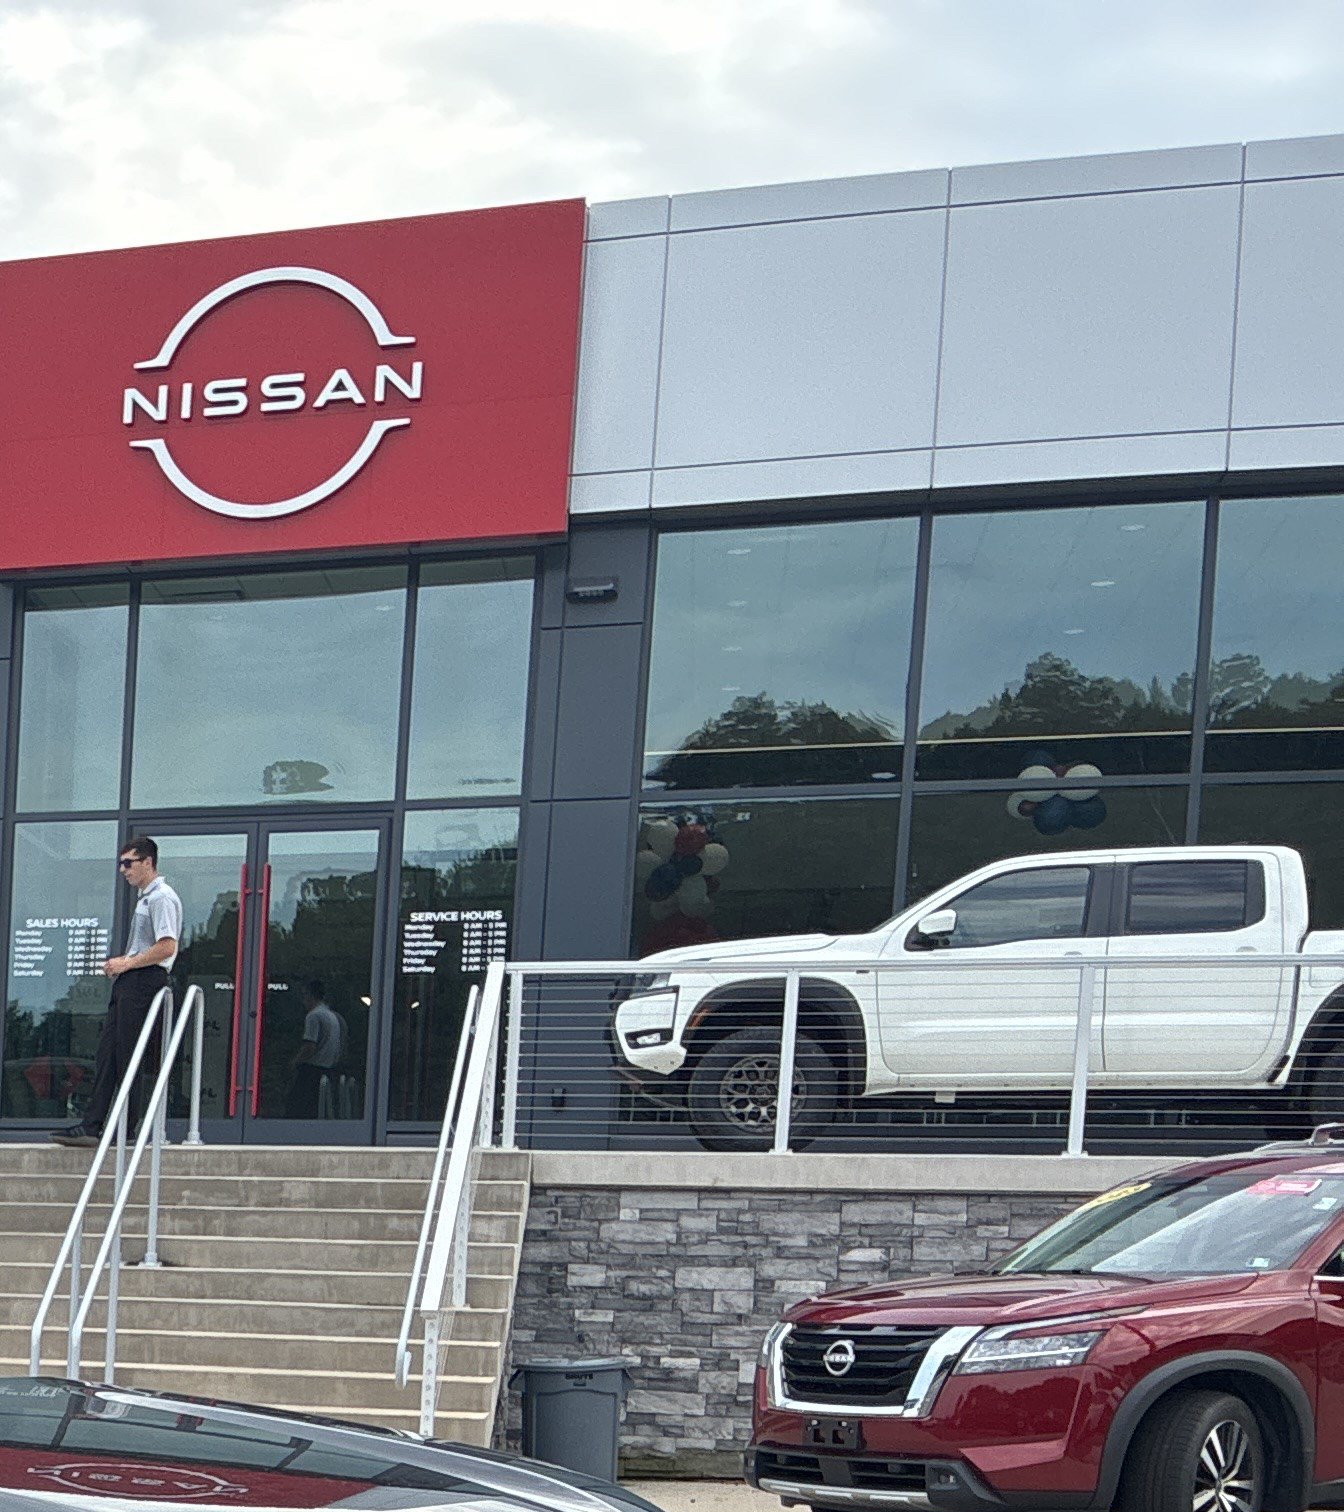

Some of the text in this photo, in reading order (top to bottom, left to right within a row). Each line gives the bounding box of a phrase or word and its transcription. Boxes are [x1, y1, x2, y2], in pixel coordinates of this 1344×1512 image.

[123, 361, 423, 425] NISSAN
[410, 910, 502, 922] SERVICE HOURS
[26, 918, 99, 928] SALES HOURS
[404, 932, 434, 940] Tuesday
